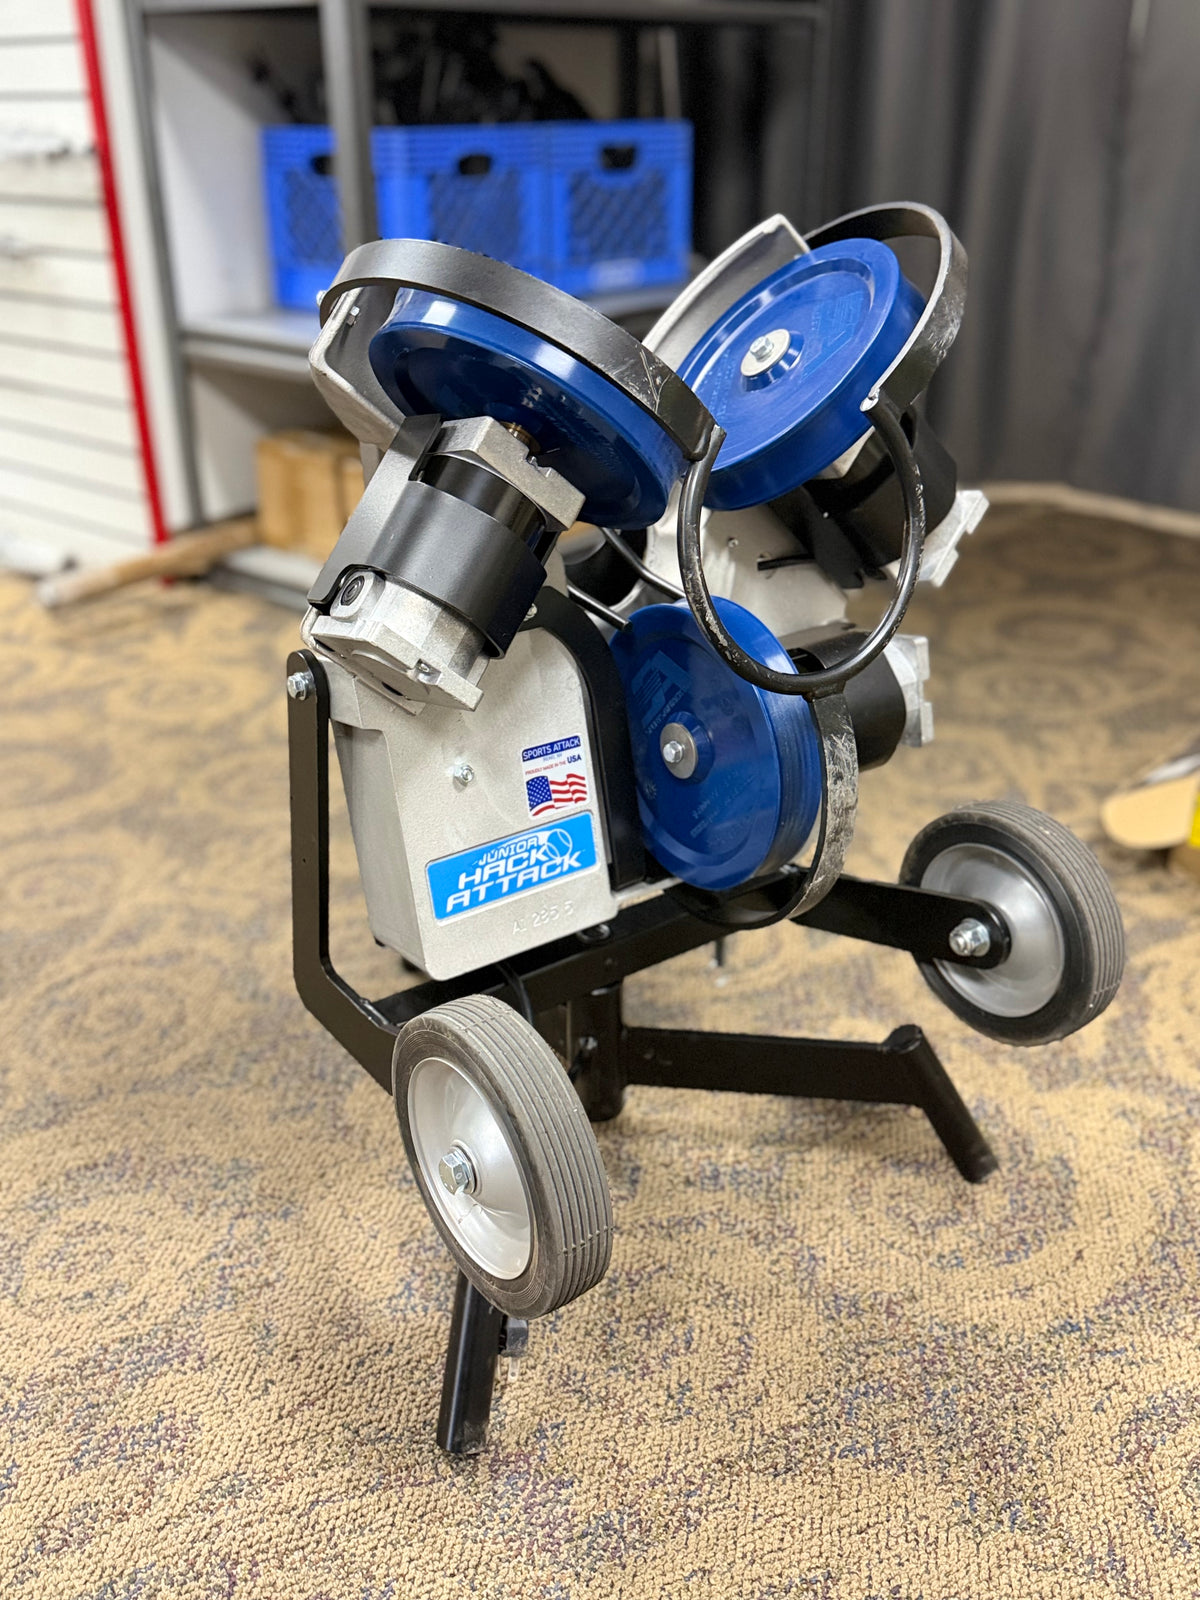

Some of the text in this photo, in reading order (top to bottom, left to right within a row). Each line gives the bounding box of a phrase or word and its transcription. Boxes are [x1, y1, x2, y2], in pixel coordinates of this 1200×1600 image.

[523, 738, 580, 760] SPORTS ATTACK
[543, 763, 553, 771] MADE
[567, 754, 582, 764] USA
[477, 837, 538, 866] JUNIOR
[446, 851, 583, 913] ATTACK
[458, 845, 551, 890] HACK
